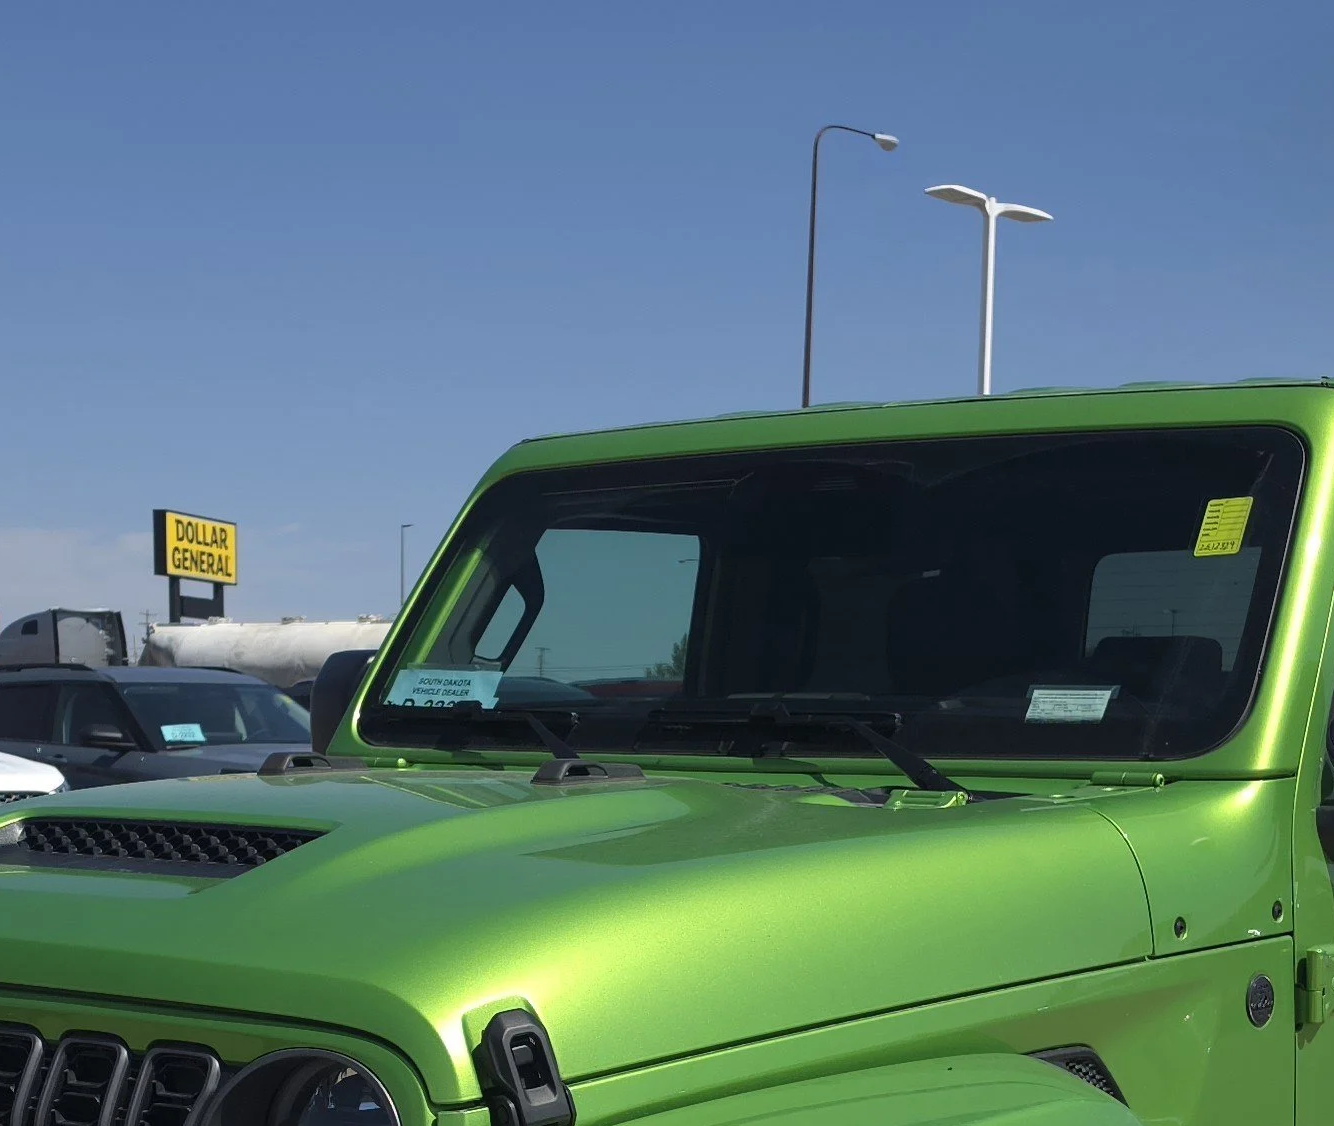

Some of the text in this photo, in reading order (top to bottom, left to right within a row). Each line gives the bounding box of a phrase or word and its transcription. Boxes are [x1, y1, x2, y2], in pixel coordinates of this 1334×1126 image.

[174, 518, 228, 550] DOLLAR
[171, 546, 232, 577] GENERAL
[412, 687, 470, 697] VEHICLE DEALER
[418, 677, 472, 687] SOUTH DAKOTA
